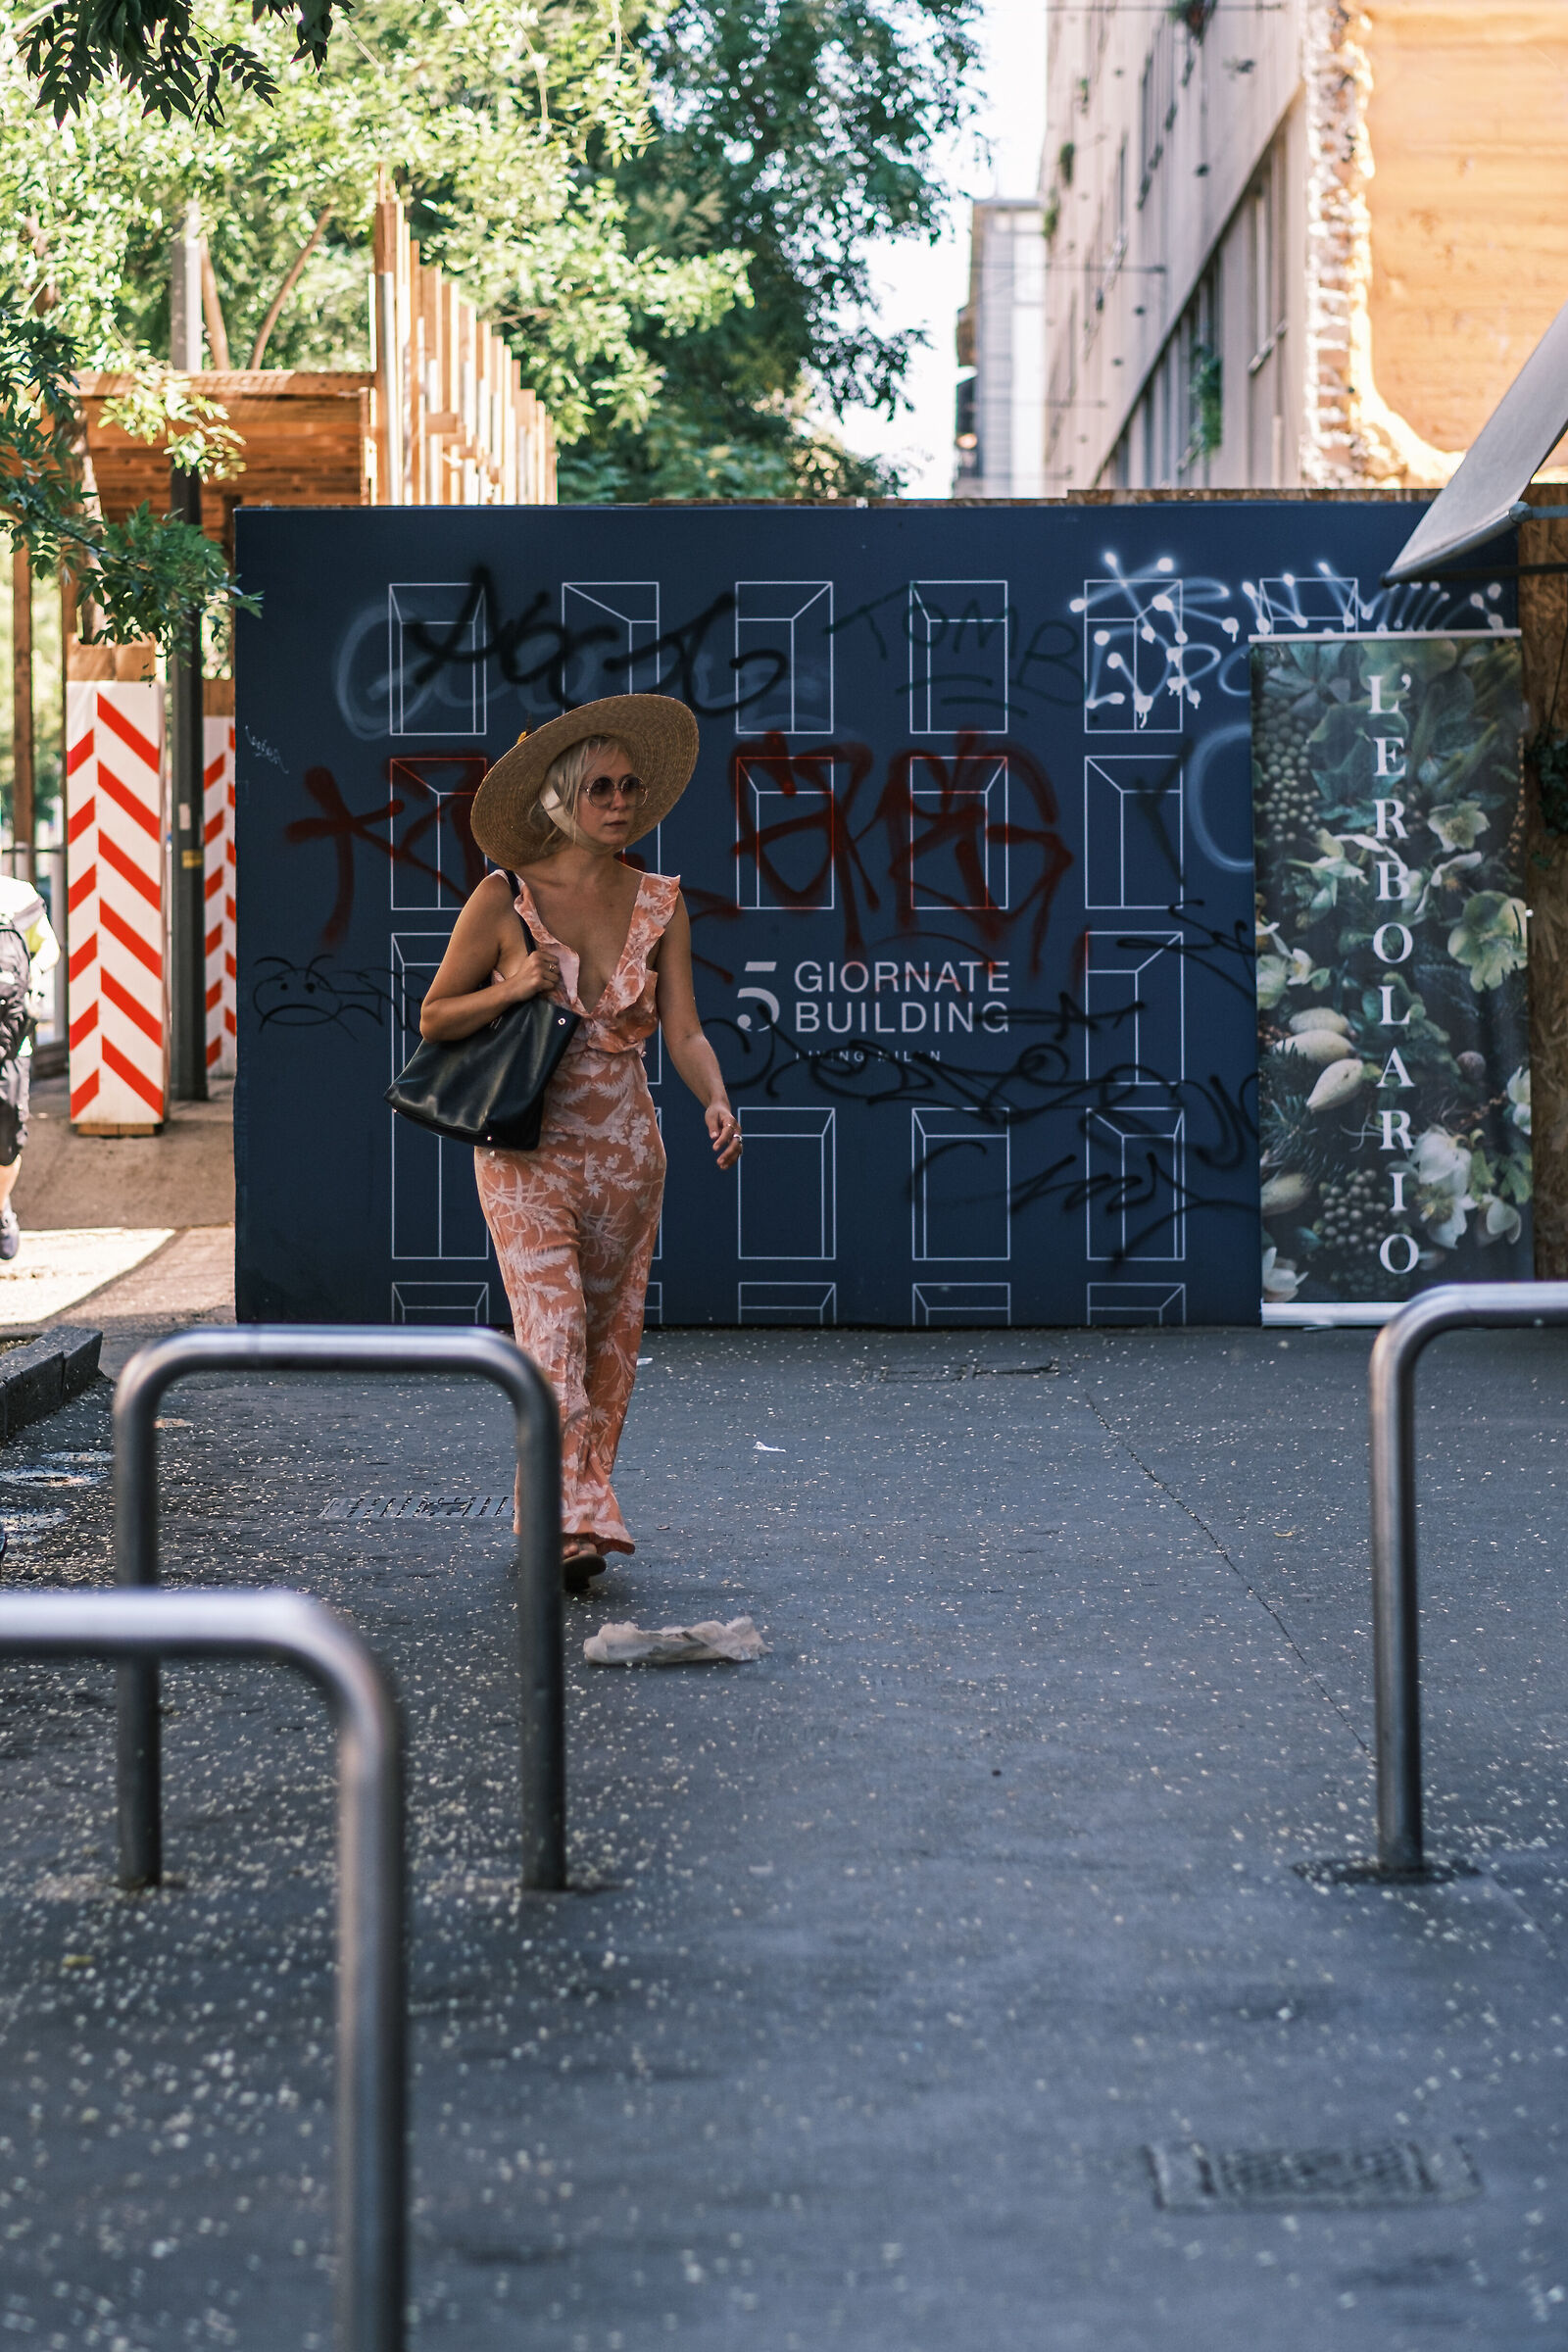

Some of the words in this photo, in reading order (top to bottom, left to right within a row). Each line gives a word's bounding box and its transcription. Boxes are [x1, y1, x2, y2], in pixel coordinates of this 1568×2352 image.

[737, 961, 780, 1032] 5
[794, 960, 1010, 993] GIORNATE
[795, 1001, 1009, 1033] BUILDING
[876, 1050, 941, 1062] ILN
